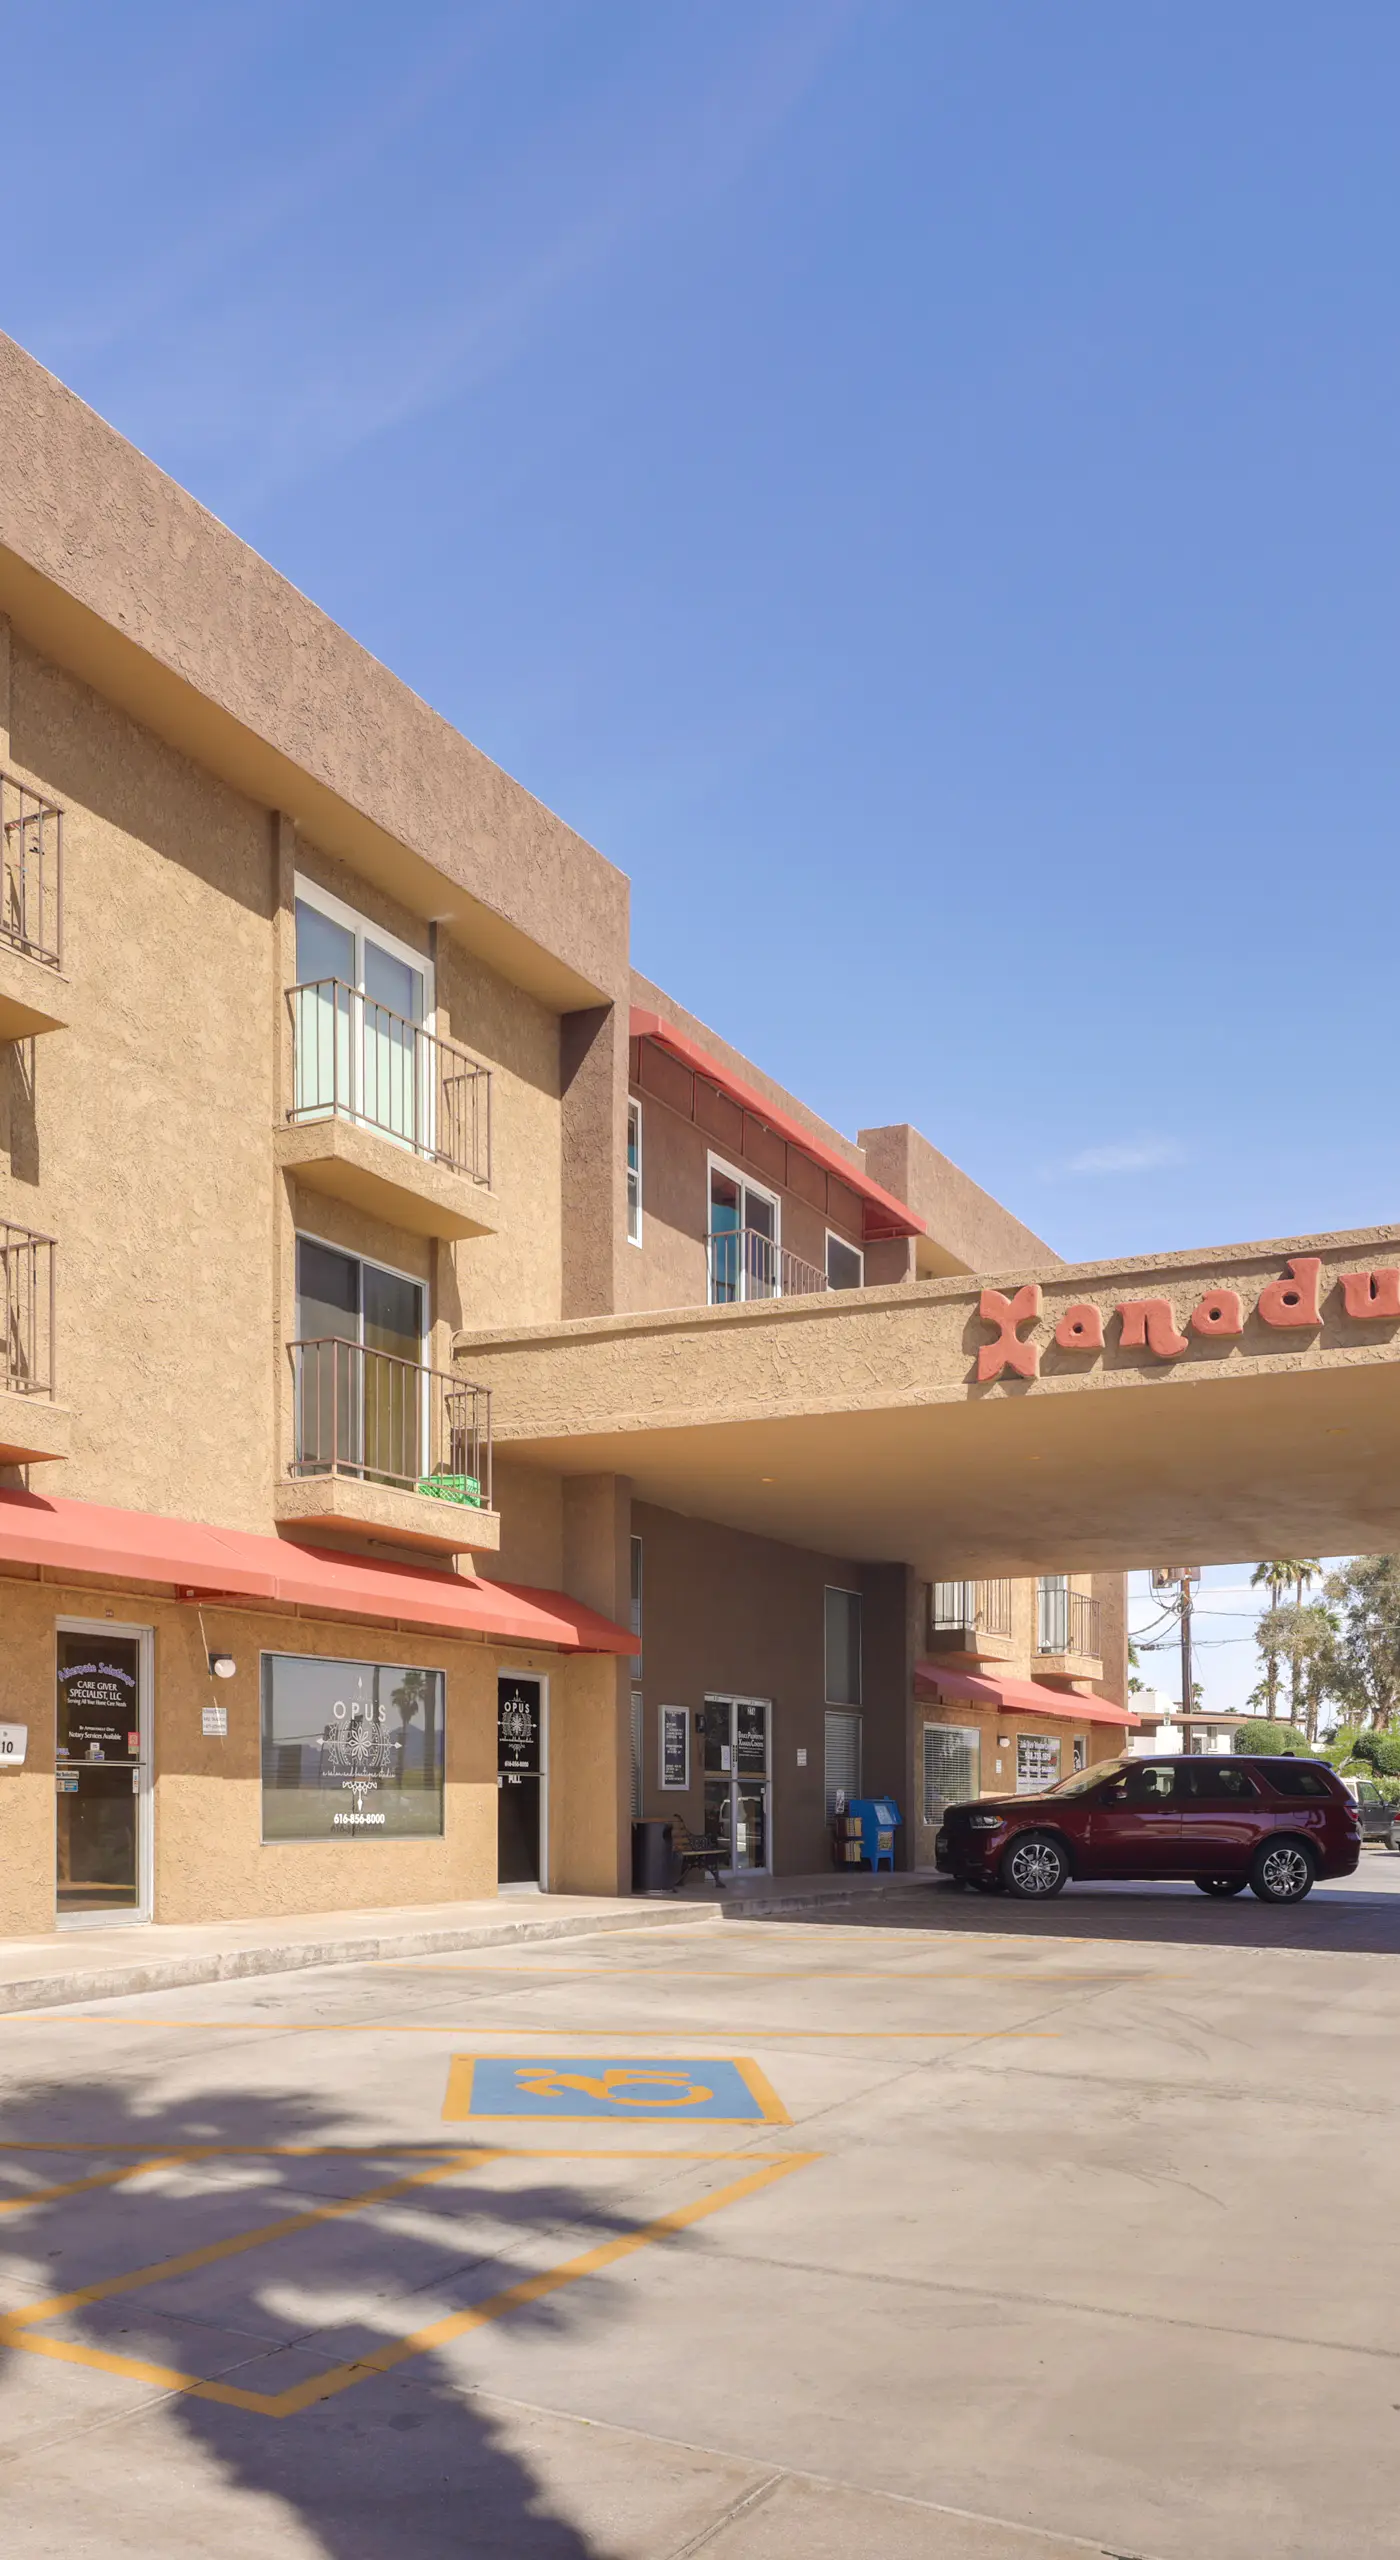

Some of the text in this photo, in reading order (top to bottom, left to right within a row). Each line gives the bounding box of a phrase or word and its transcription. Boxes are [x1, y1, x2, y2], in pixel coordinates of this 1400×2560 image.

[977, 1257, 1400, 1384] Xanadu
[98, 1662, 135, 1687] Solutions
[77, 1680, 118, 1692] CARE GIVER
[69, 1688, 122, 1701] SPECIALIST, LLC
[67, 1697, 81, 1706] Serving
[333, 1701, 387, 1722] OPUS
[504, 1702, 530, 1714] OPUS
[69, 1731, 122, 1741] Notary Services Available
[1, 1741, 13, 1754] 10
[333, 1813, 386, 1824] 616-856-8000
